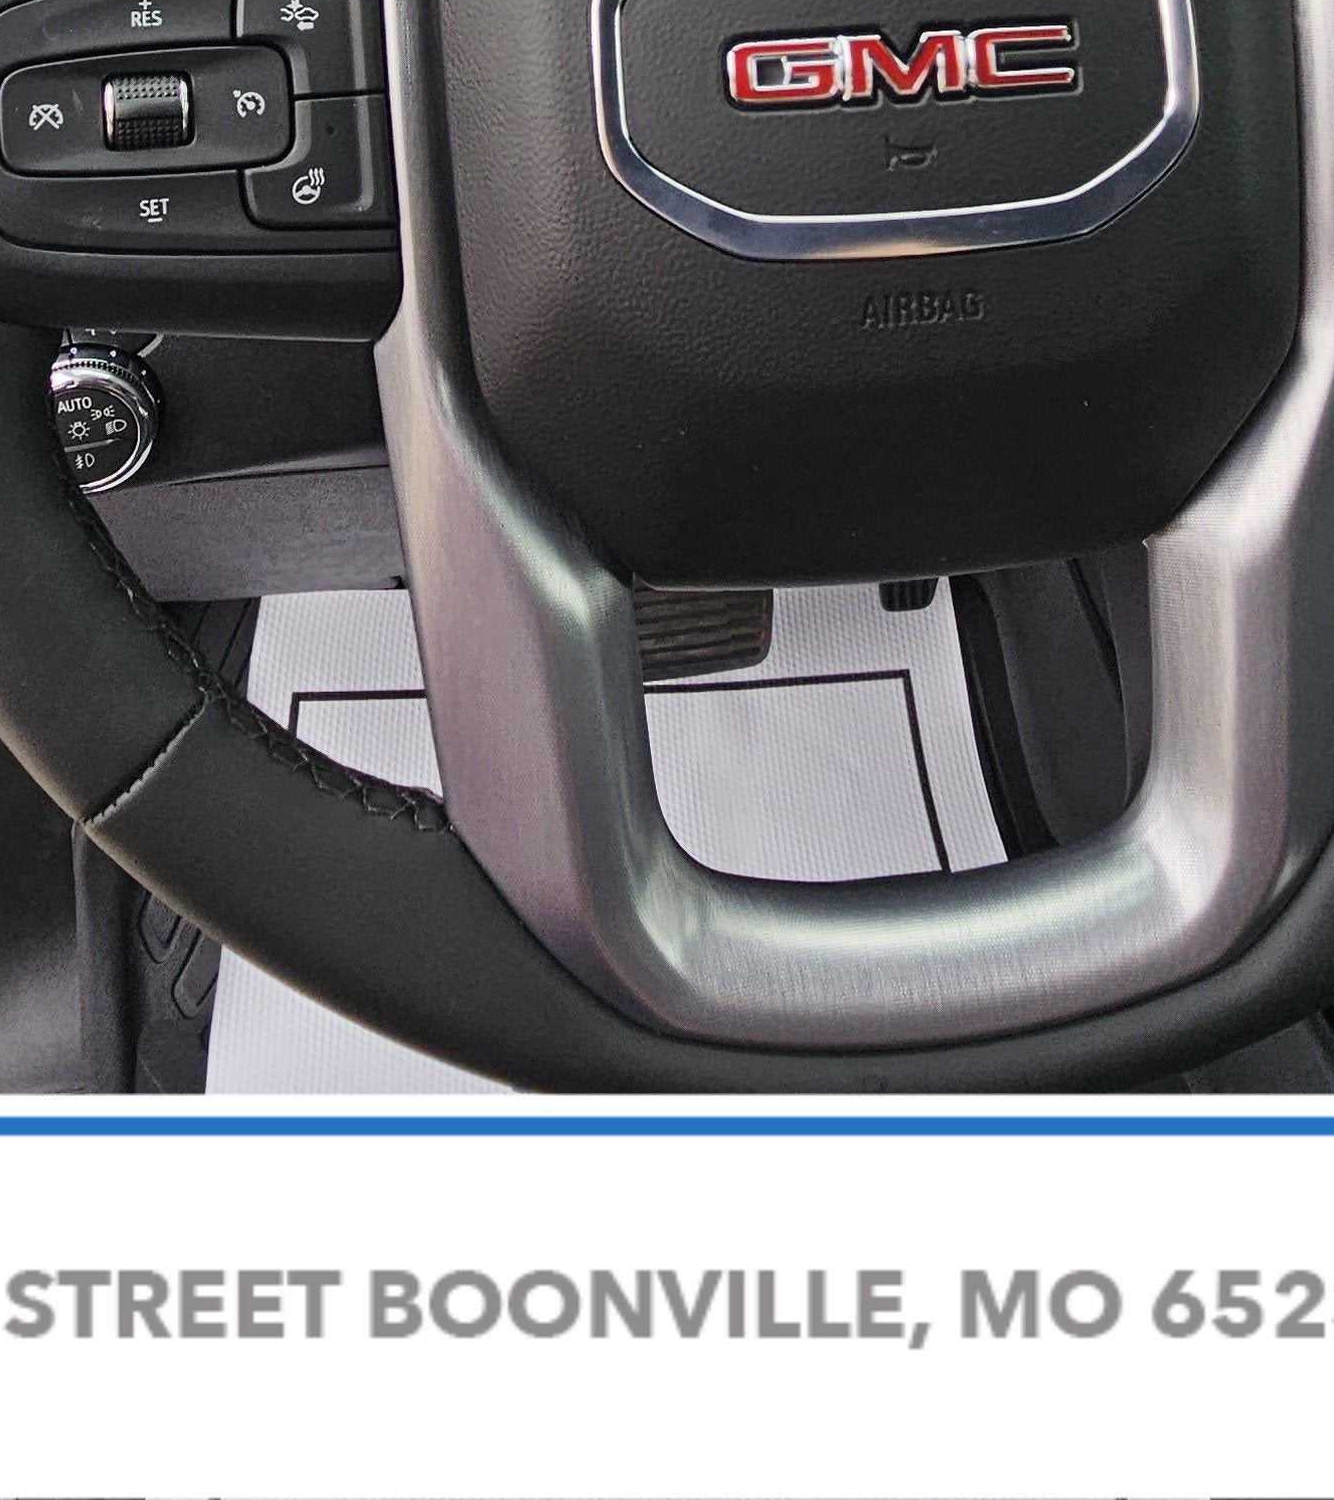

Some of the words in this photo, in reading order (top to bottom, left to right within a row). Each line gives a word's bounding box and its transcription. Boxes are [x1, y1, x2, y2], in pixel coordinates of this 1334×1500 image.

[131, 11, 163, 28] RES
[727, 25, 1075, 102] GMC
[139, 199, 170, 217] SET
[859, 292, 987, 330] AIRBAG
[57, 396, 92, 414] AUTO
